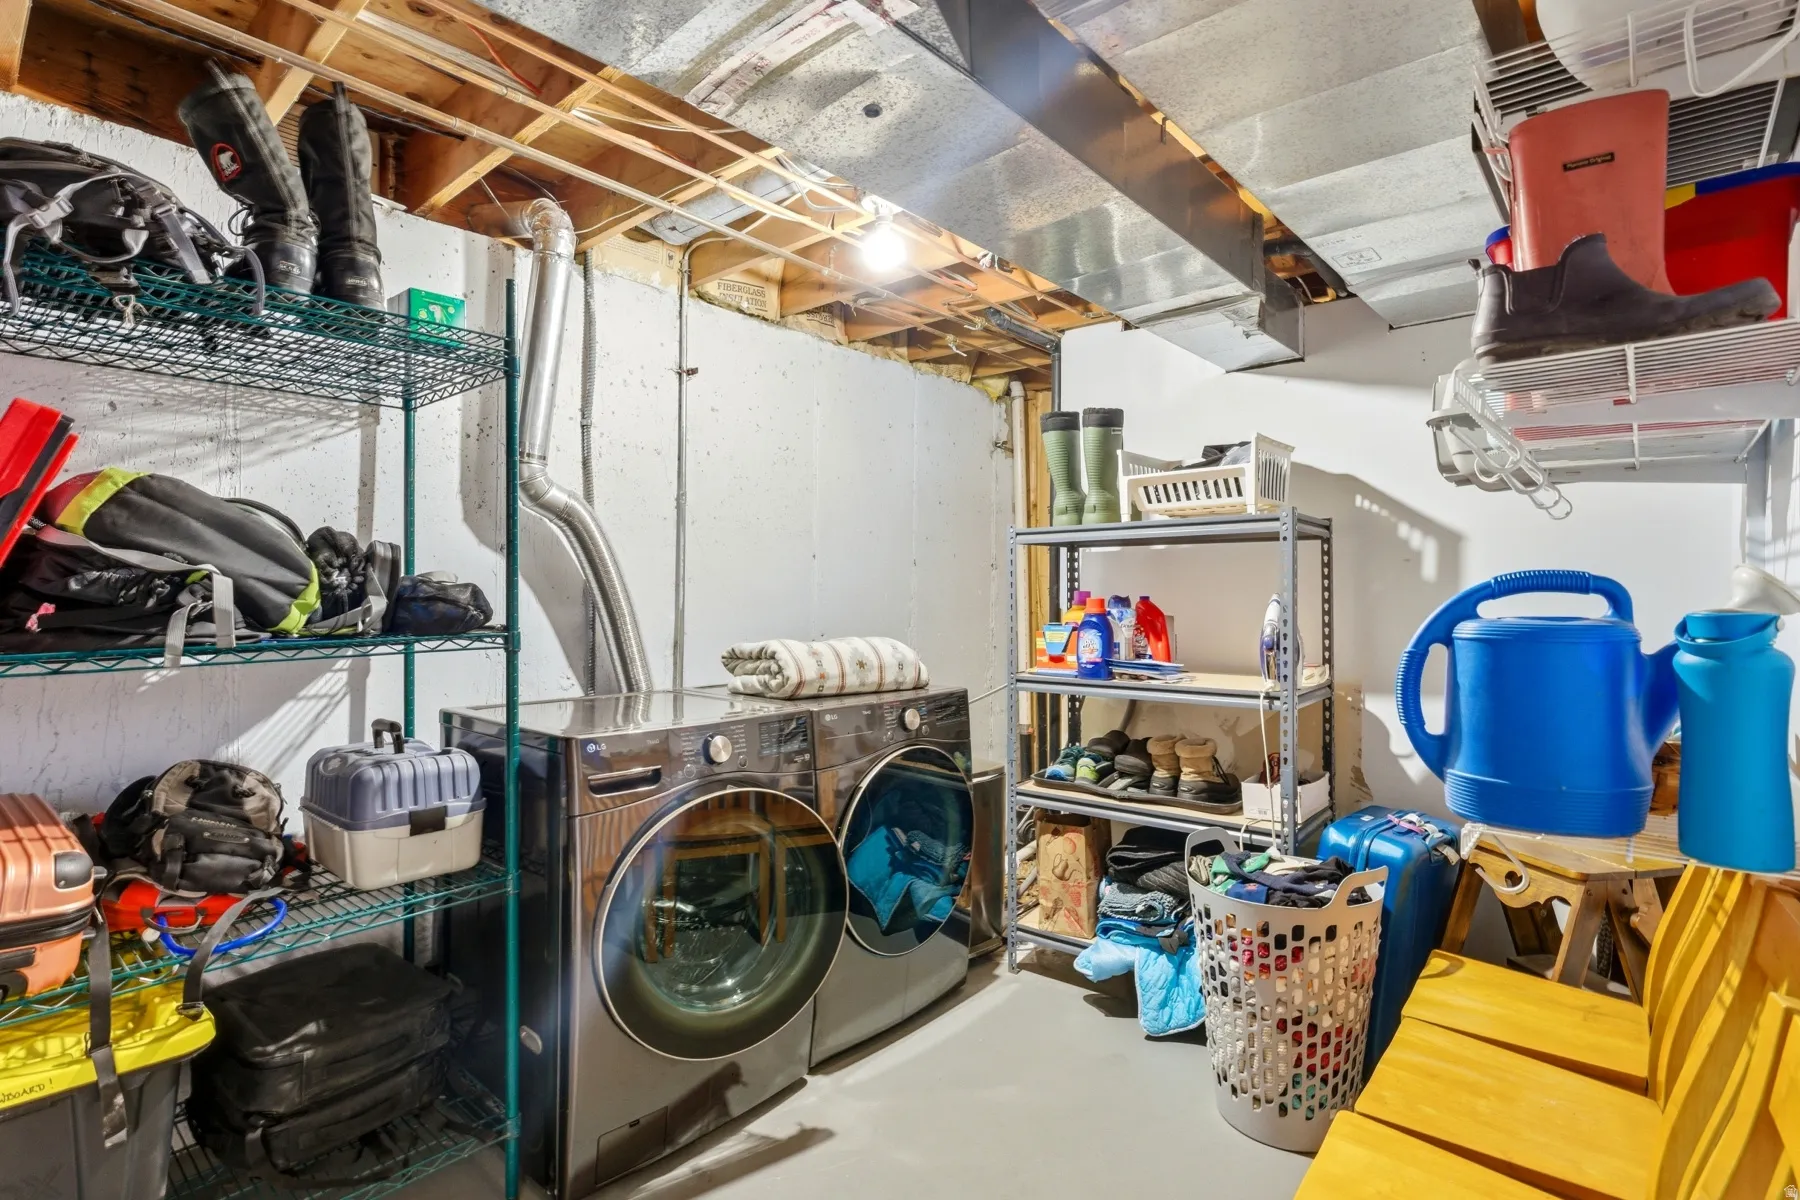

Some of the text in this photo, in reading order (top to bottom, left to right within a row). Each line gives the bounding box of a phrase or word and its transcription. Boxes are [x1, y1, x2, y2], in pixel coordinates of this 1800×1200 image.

[717, 281, 766, 298] FIBERGLASS
[719, 292, 768, 308] INSULATION
[596, 743, 607, 751] LG
